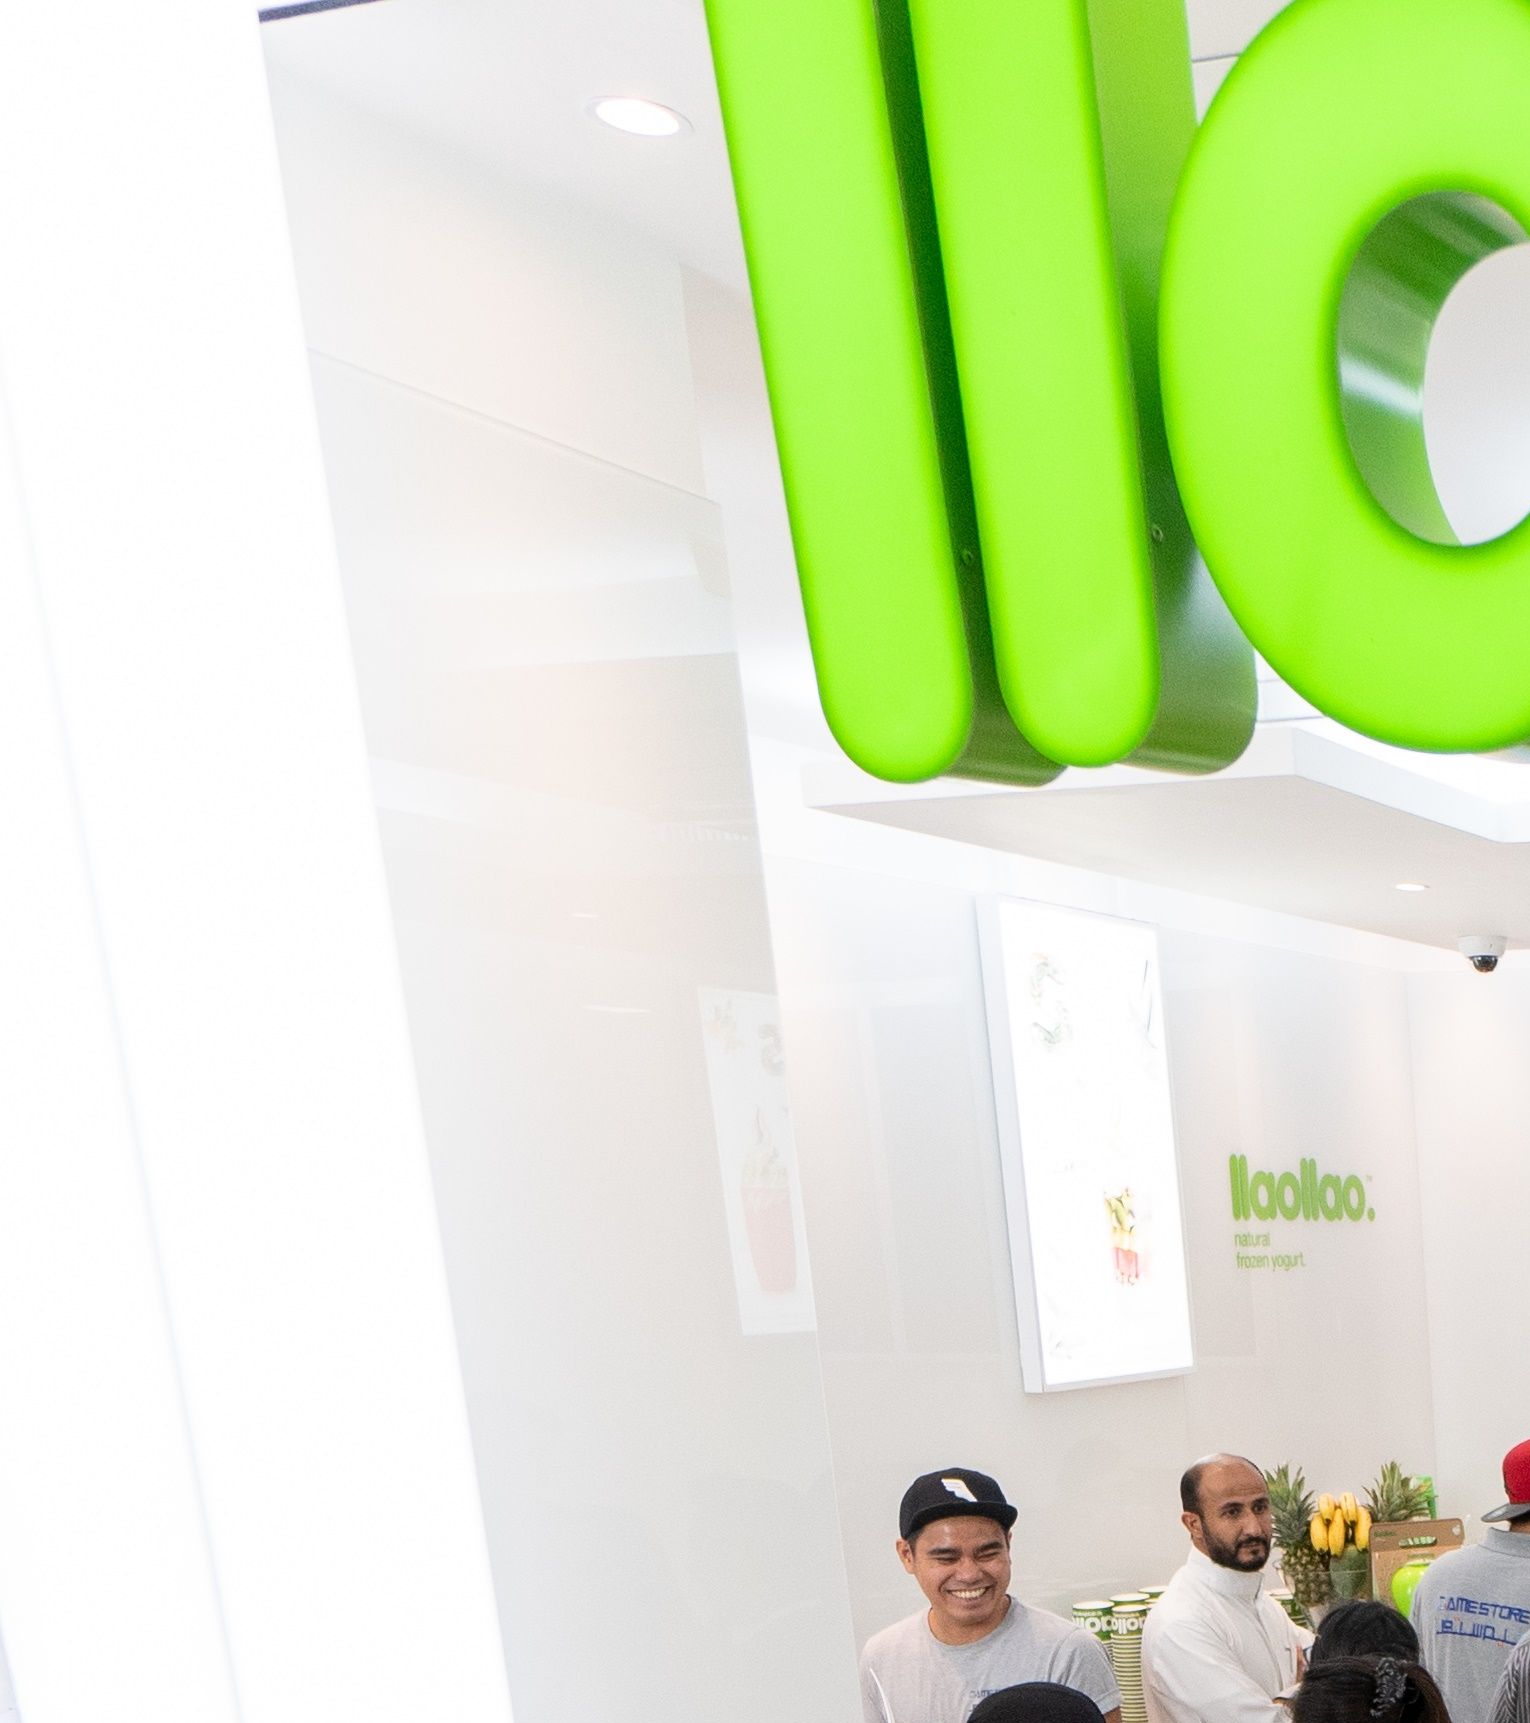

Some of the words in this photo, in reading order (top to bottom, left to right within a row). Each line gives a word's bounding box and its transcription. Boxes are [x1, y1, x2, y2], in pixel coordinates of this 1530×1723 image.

[1234, 1232, 1270, 1247] natural
[1236, 1252, 1269, 1269] frozen
[1271, 1252, 1306, 1271] yogurt
